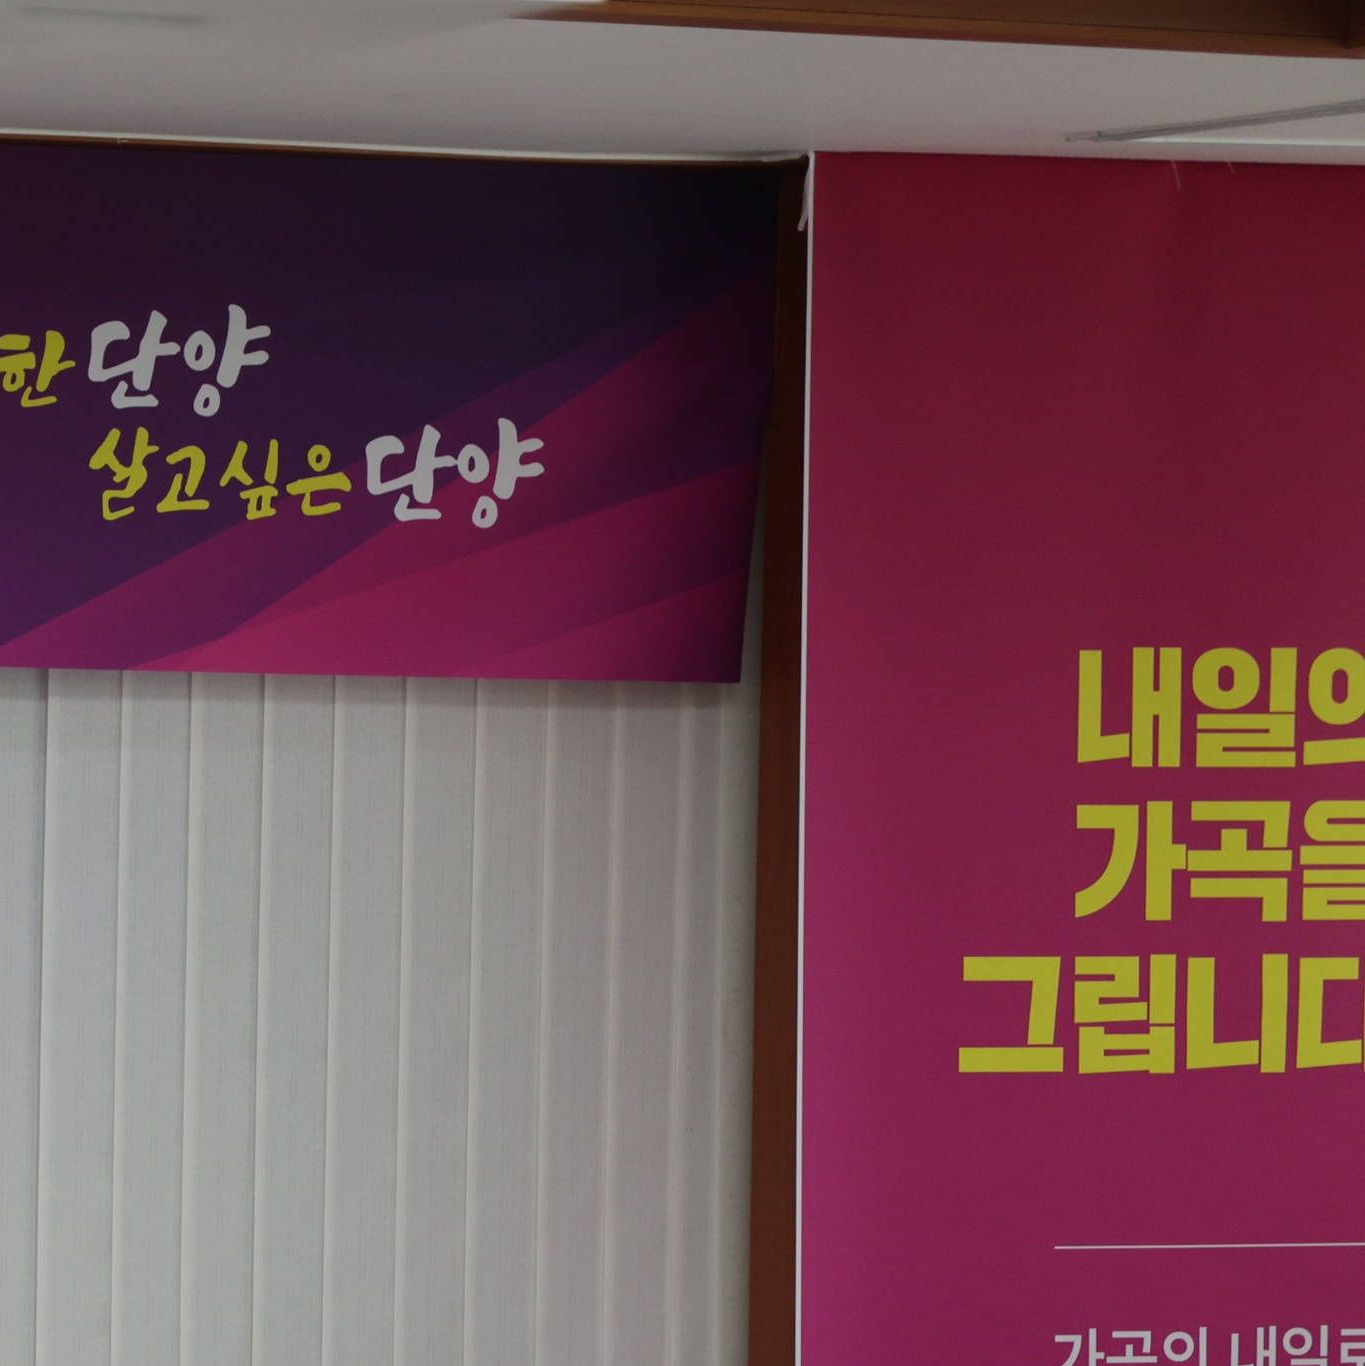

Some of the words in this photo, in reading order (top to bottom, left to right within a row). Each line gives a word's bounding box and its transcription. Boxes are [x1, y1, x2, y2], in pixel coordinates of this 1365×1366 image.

[87, 304, 271, 417] 단양
[365, 417, 545, 529] 단양
[1075, 800, 1365, 922] 가곡을
